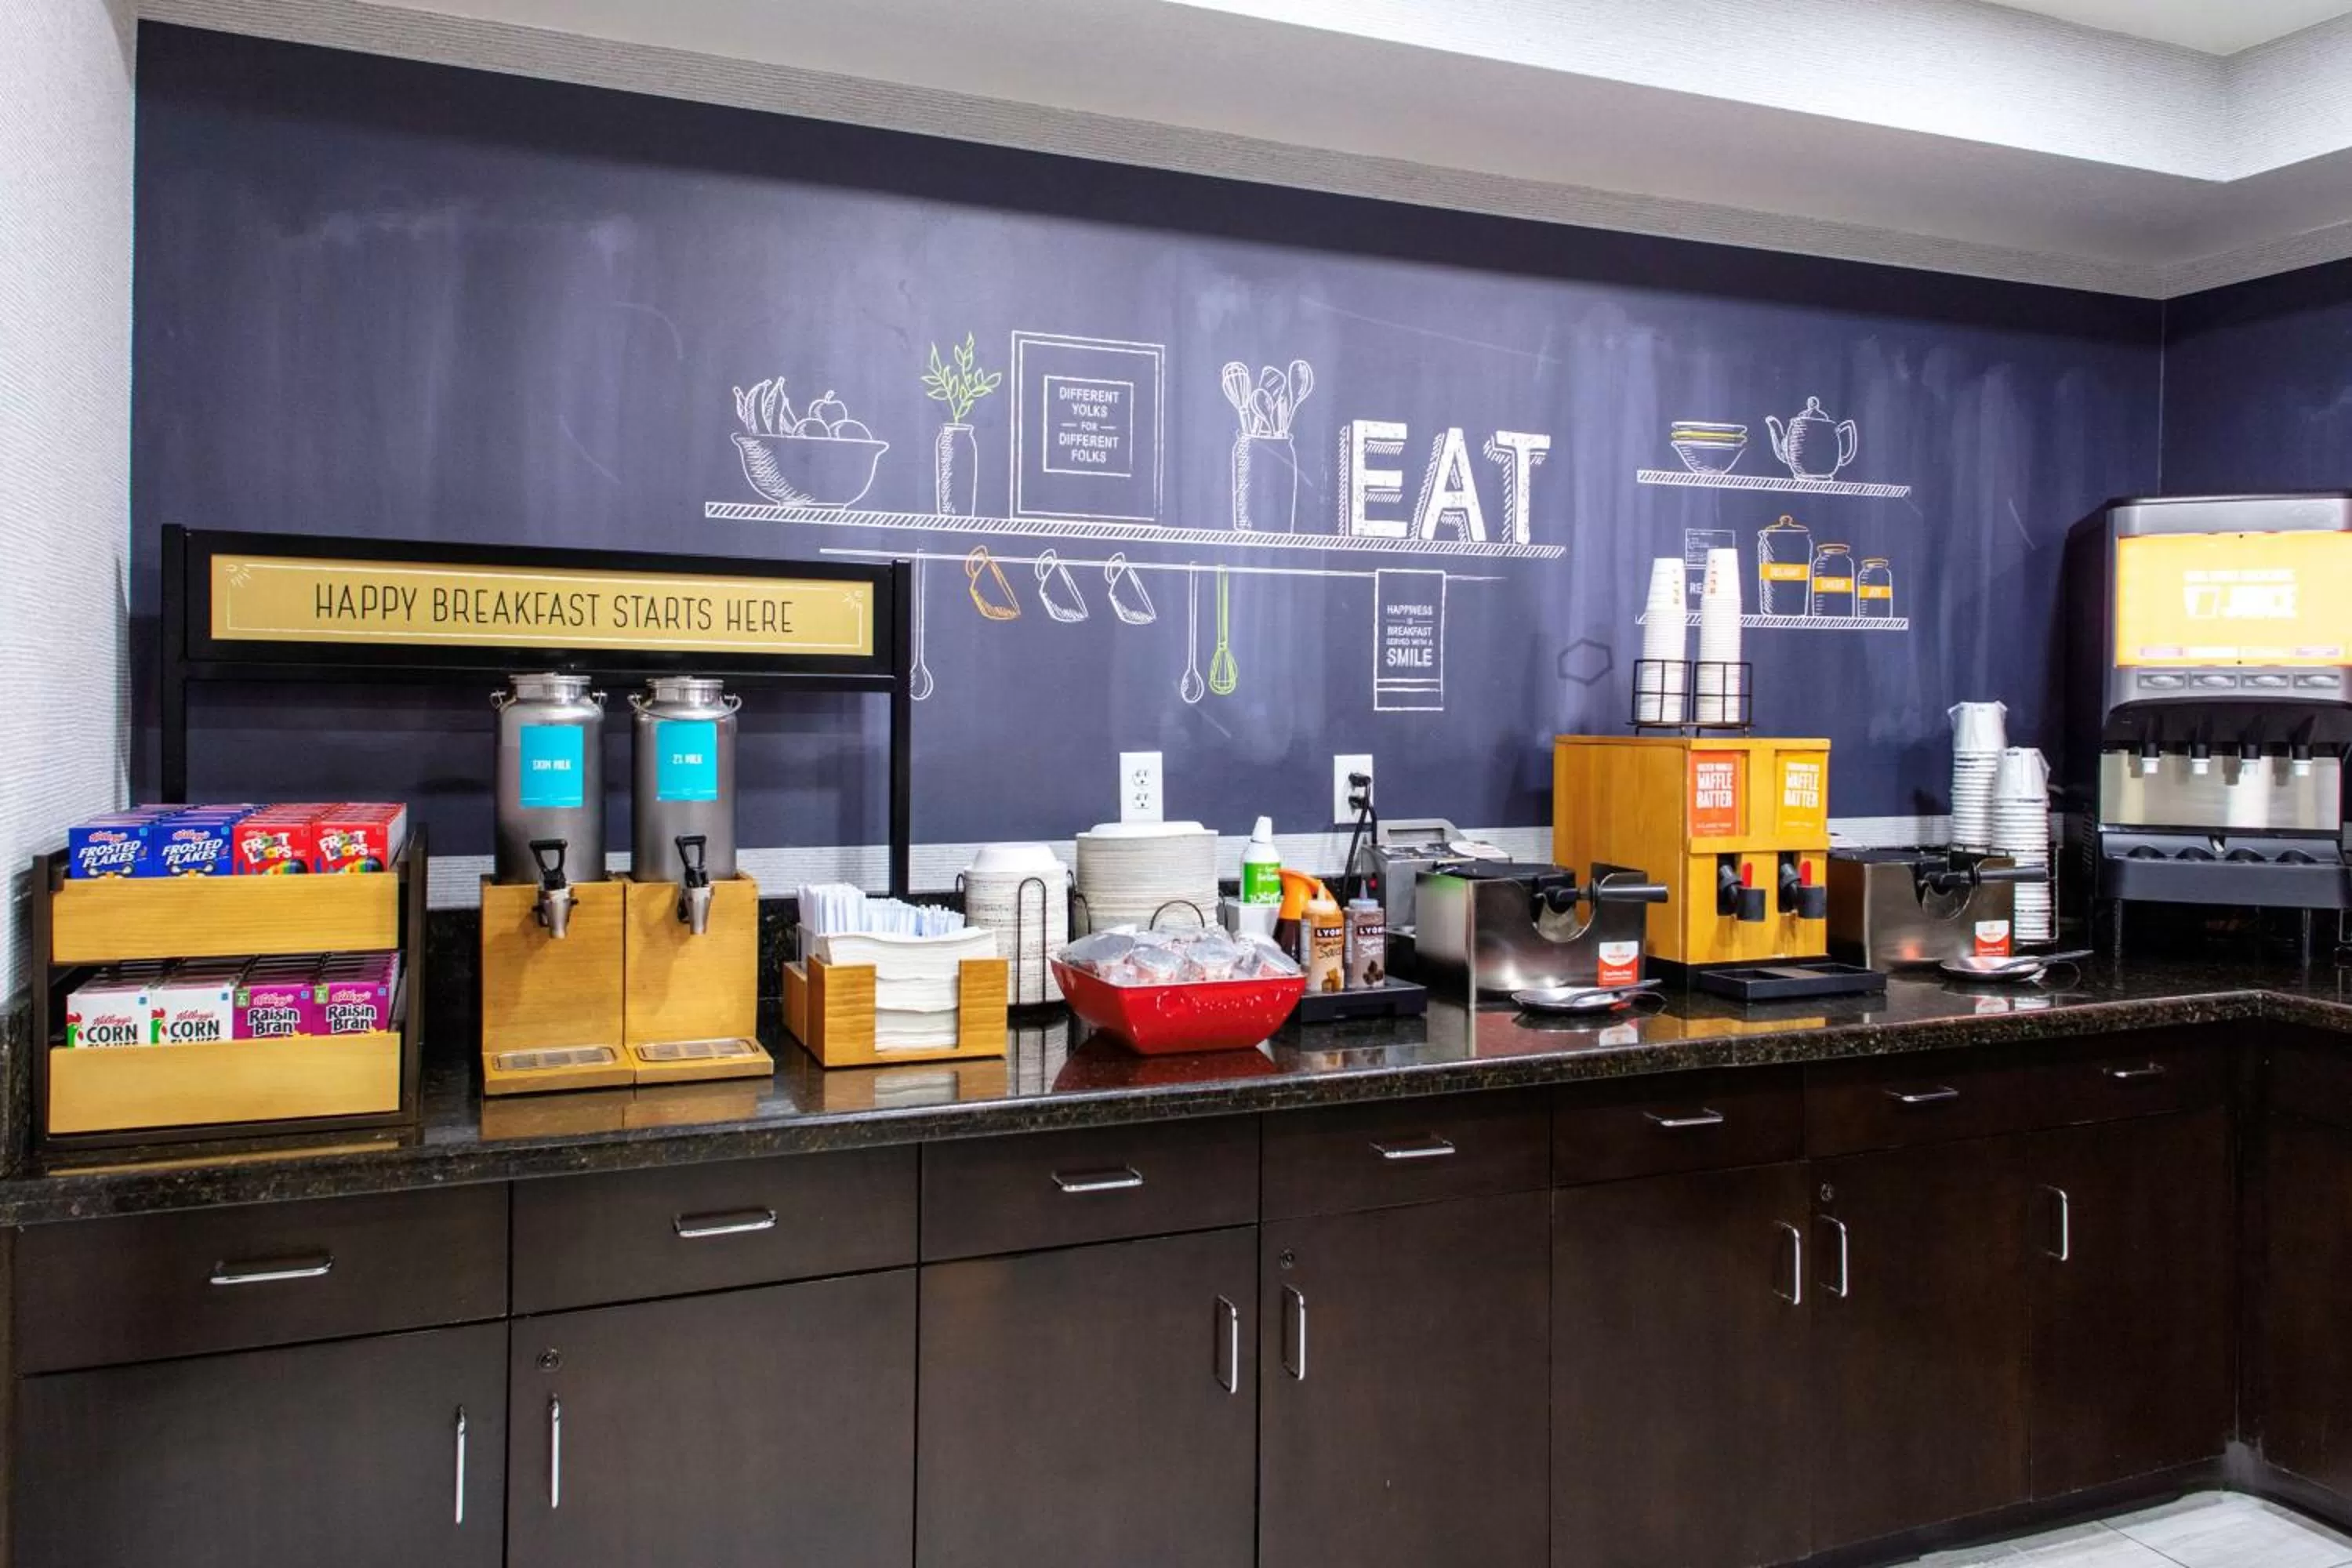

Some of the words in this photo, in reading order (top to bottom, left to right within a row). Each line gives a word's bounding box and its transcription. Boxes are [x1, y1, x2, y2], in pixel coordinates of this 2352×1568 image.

[1059, 387, 1120, 404] DIFFERENT
[1072, 403, 1108, 418] YOLKS
[1081, 421, 1098, 431] FOR
[1059, 432, 1120, 449] DIFFERENT
[1071, 448, 1106, 464] FOLKS
[1338, 419, 1551, 546] EAT
[316, 583, 418, 622] HAPPY
[434, 588, 601, 626] BREAKFAST
[614, 595, 712, 630] STARTS
[727, 600, 794, 633] HERE
[1386, 604, 1433, 616] HAPPINESS
[1387, 626, 1433, 637] BREAKFAST
[1386, 647, 1433, 667] SMILE
[1697, 771, 1734, 790] WAFFLE
[1786, 771, 1820, 790] WAFFLE
[1696, 789, 1733, 809] BATTER
[1784, 789, 1820, 808] BATTER
[78, 840, 142, 859] FROSTED
[162, 838, 224, 857] FROSTED
[82, 851, 136, 869] FLAKES
[165, 850, 219, 866] FLAKES
[248, 1007, 300, 1025] Raisin
[326, 1004, 377, 1022] Raisin
[86, 1024, 138, 1044] CORN
[169, 1020, 220, 1039] CORN
[252, 1021, 296, 1038] Bran
[331, 1018, 373, 1034] Bran
